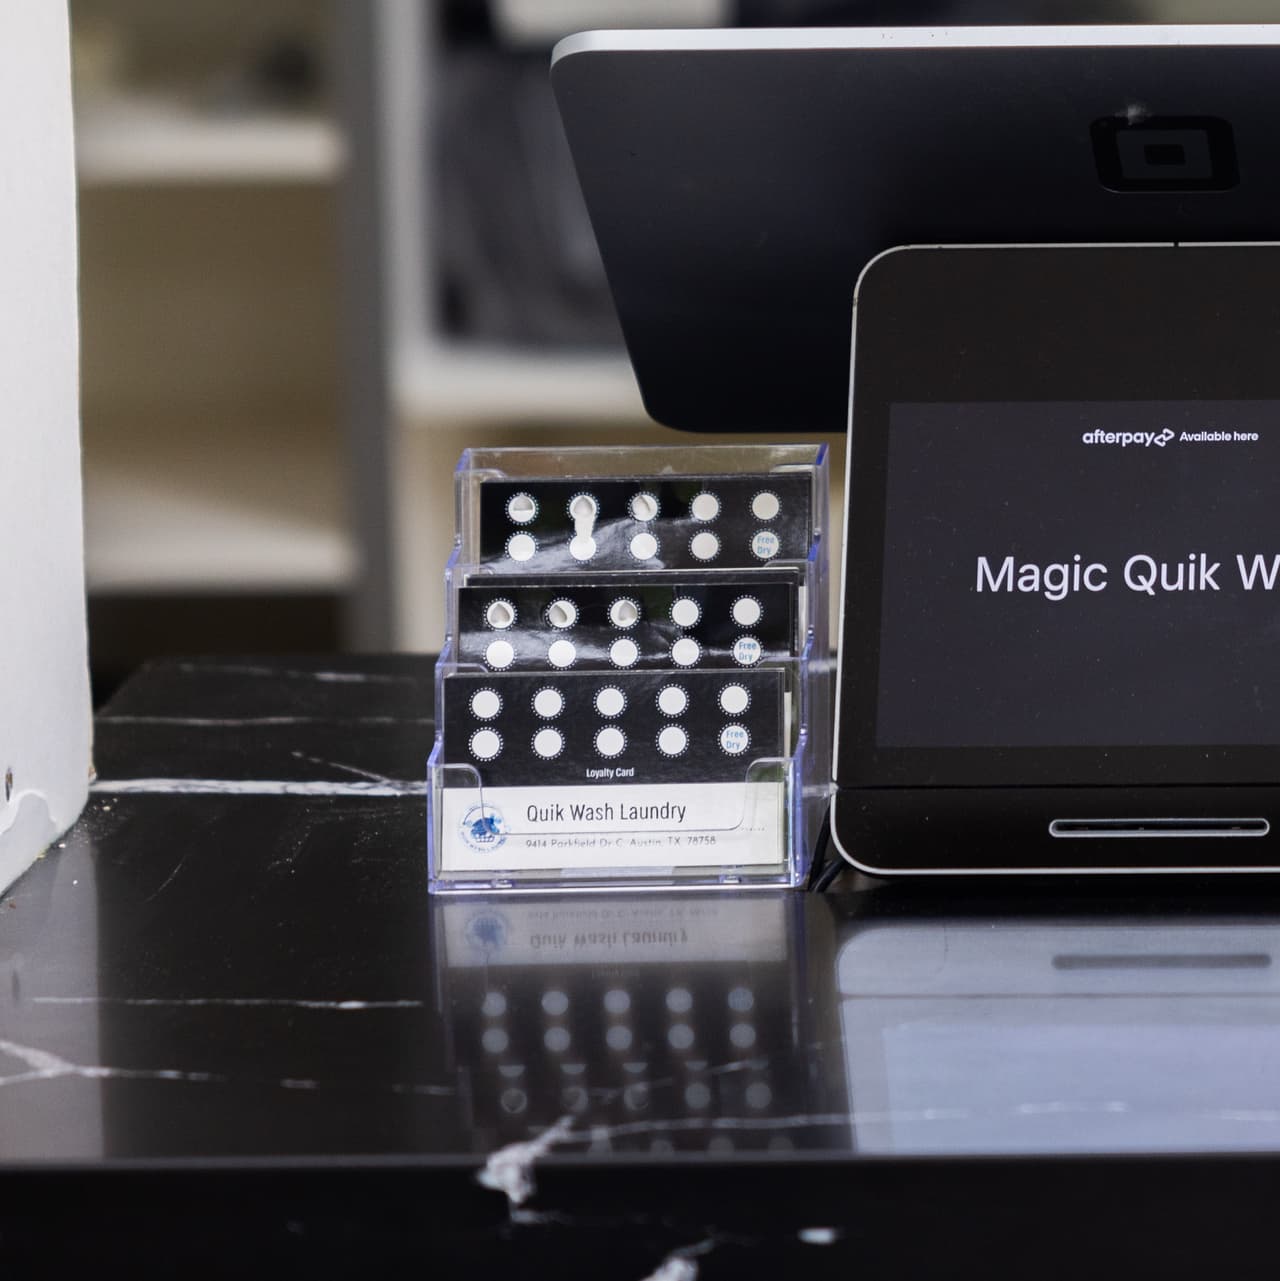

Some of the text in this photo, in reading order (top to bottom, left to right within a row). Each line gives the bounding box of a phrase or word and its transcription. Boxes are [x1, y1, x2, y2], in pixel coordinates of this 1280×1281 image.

[1082, 428, 1155, 447] afterpay
[1179, 431, 1259, 442] Available here
[976, 554, 1108, 601] Magic
[1123, 552, 1221, 596] Quik
[739, 642, 757, 650] Free
[739, 652, 753, 662] Dry
[726, 730, 744, 738] Free
[726, 740, 740, 750] Dry
[586, 766, 635, 780] Loyalty Card
[527, 801, 687, 823] Quik Wash Laundry
[525, 838, 548, 848] 9414
[687, 835, 717, 846] 78758
